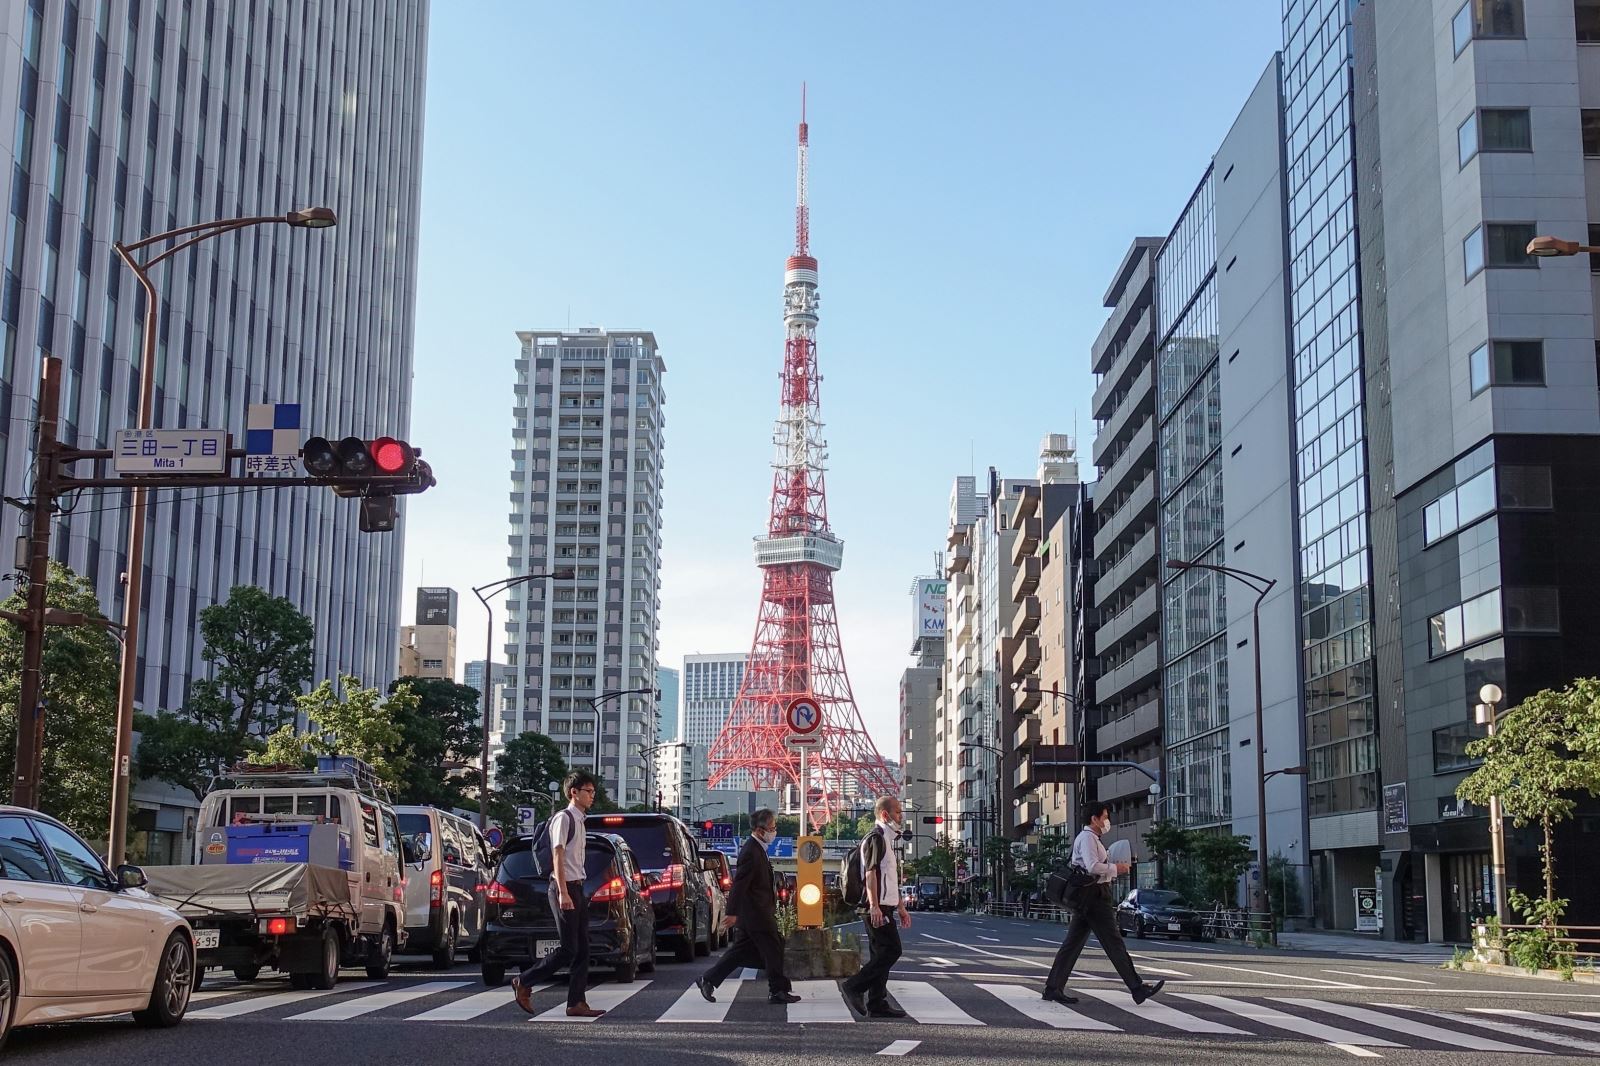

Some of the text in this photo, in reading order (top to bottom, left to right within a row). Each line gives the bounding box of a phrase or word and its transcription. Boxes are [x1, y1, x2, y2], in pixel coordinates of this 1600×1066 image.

[121, 439, 217, 456] 三田一丁目
[153, 458, 184, 468] Mita 1
[247, 456, 297, 471] 時差式
[520, 809, 532, 824] P
